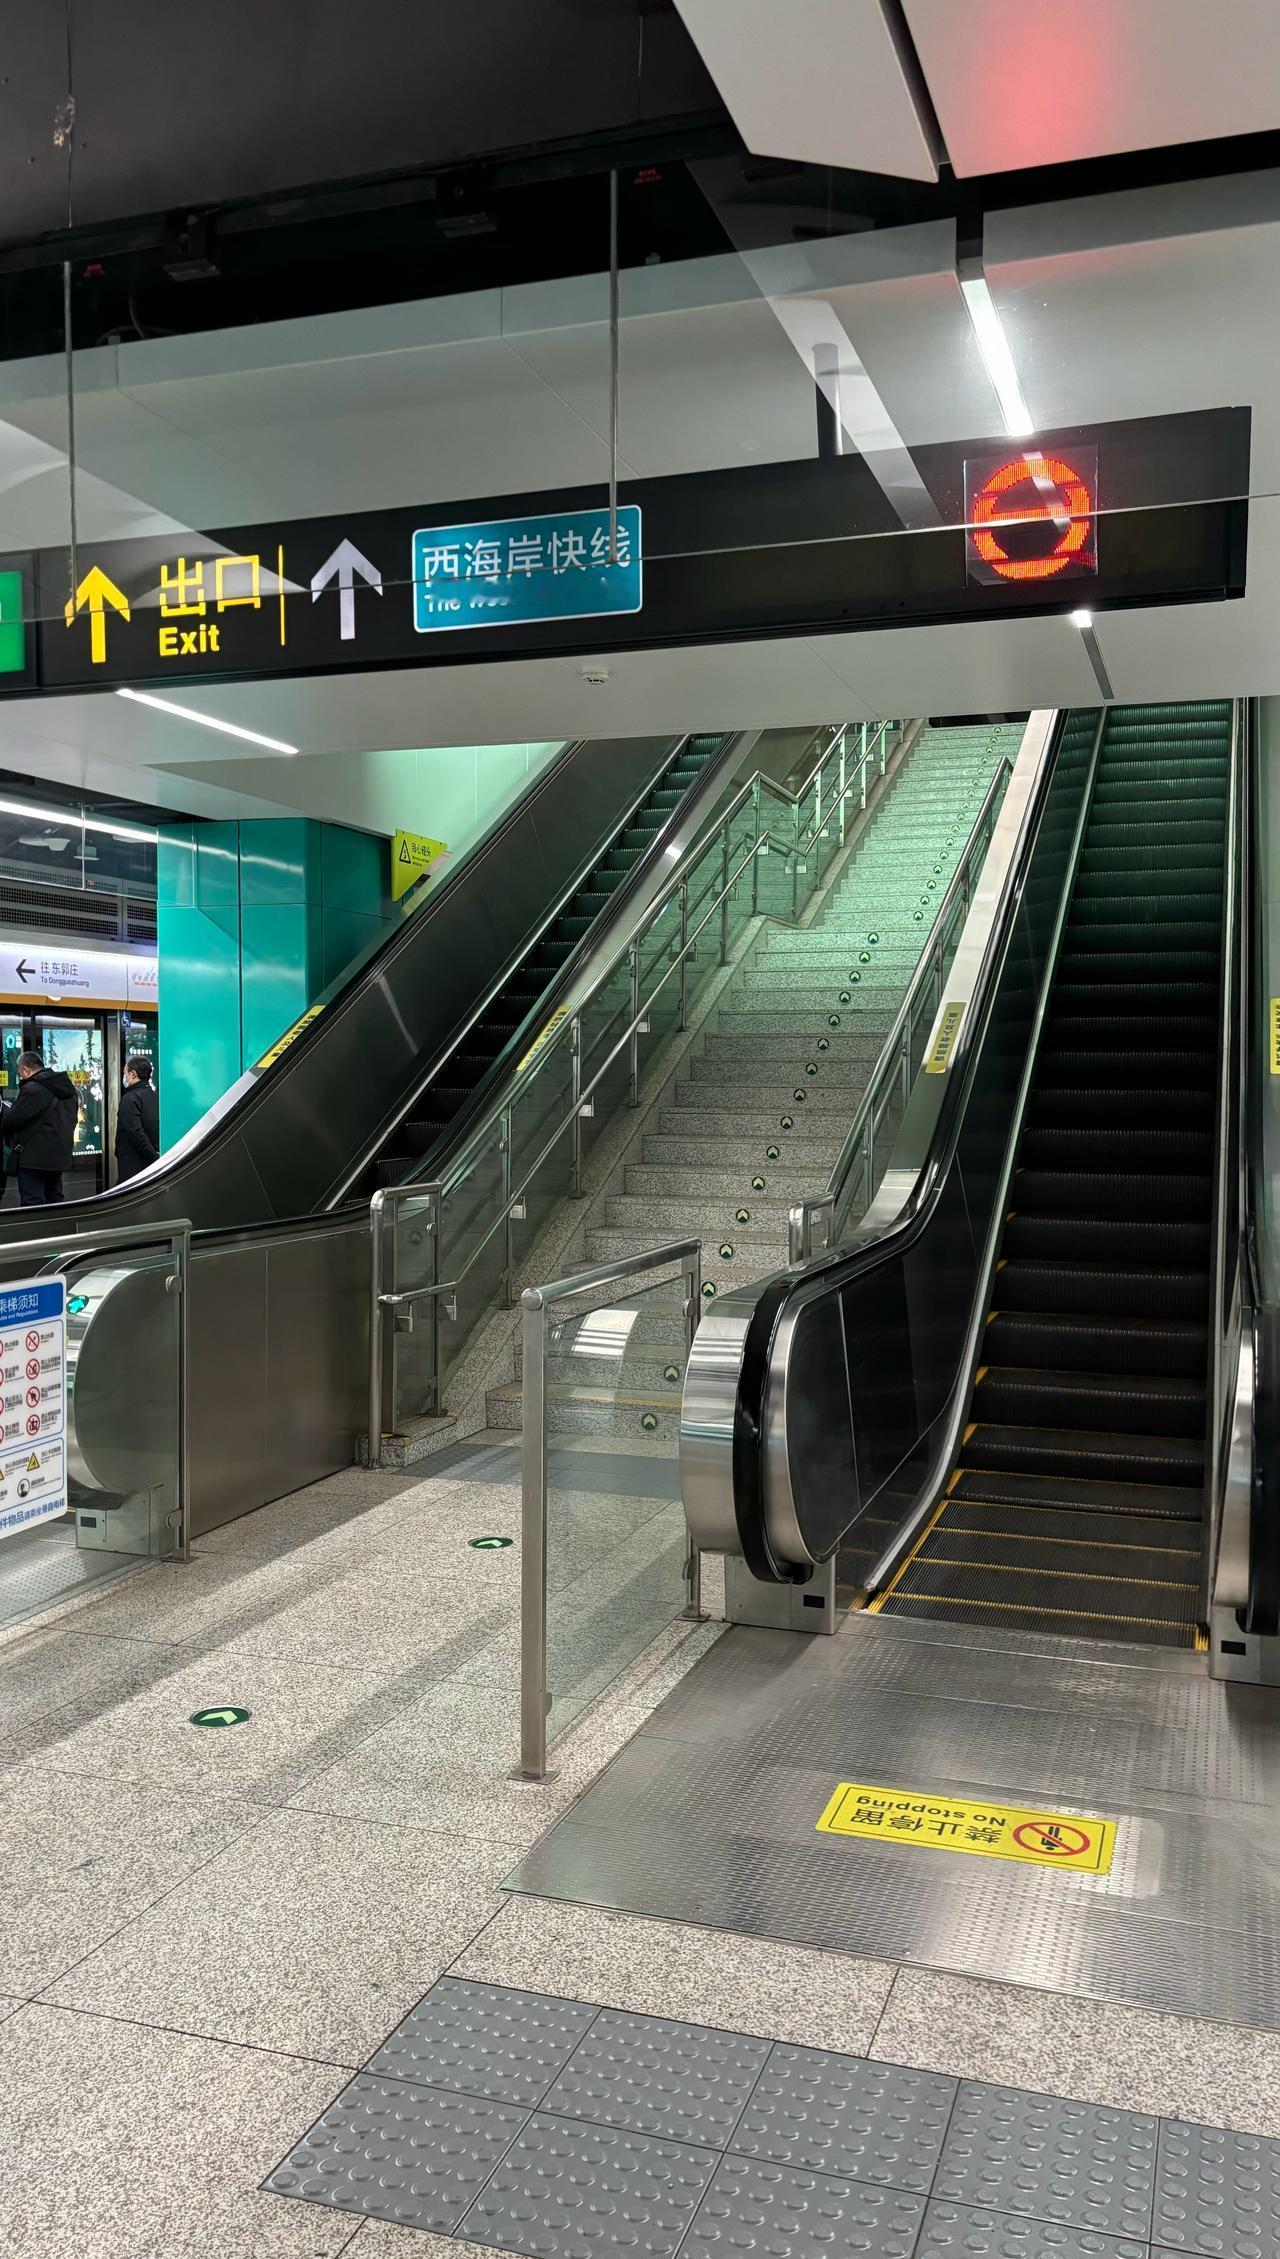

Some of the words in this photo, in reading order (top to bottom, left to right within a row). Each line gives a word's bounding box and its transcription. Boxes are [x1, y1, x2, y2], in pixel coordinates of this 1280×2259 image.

[423, 526, 631, 587] 西海岸快线
[159, 554, 262, 617] 出口
[158, 624, 221, 657] Exit
[40, 961, 50, 974] 往
[40, 976, 48, 984] To
[855, 1795, 966, 1820] stopping
[973, 1814, 1006, 1828] No
[850, 1808, 1003, 1844] 禁止停留
